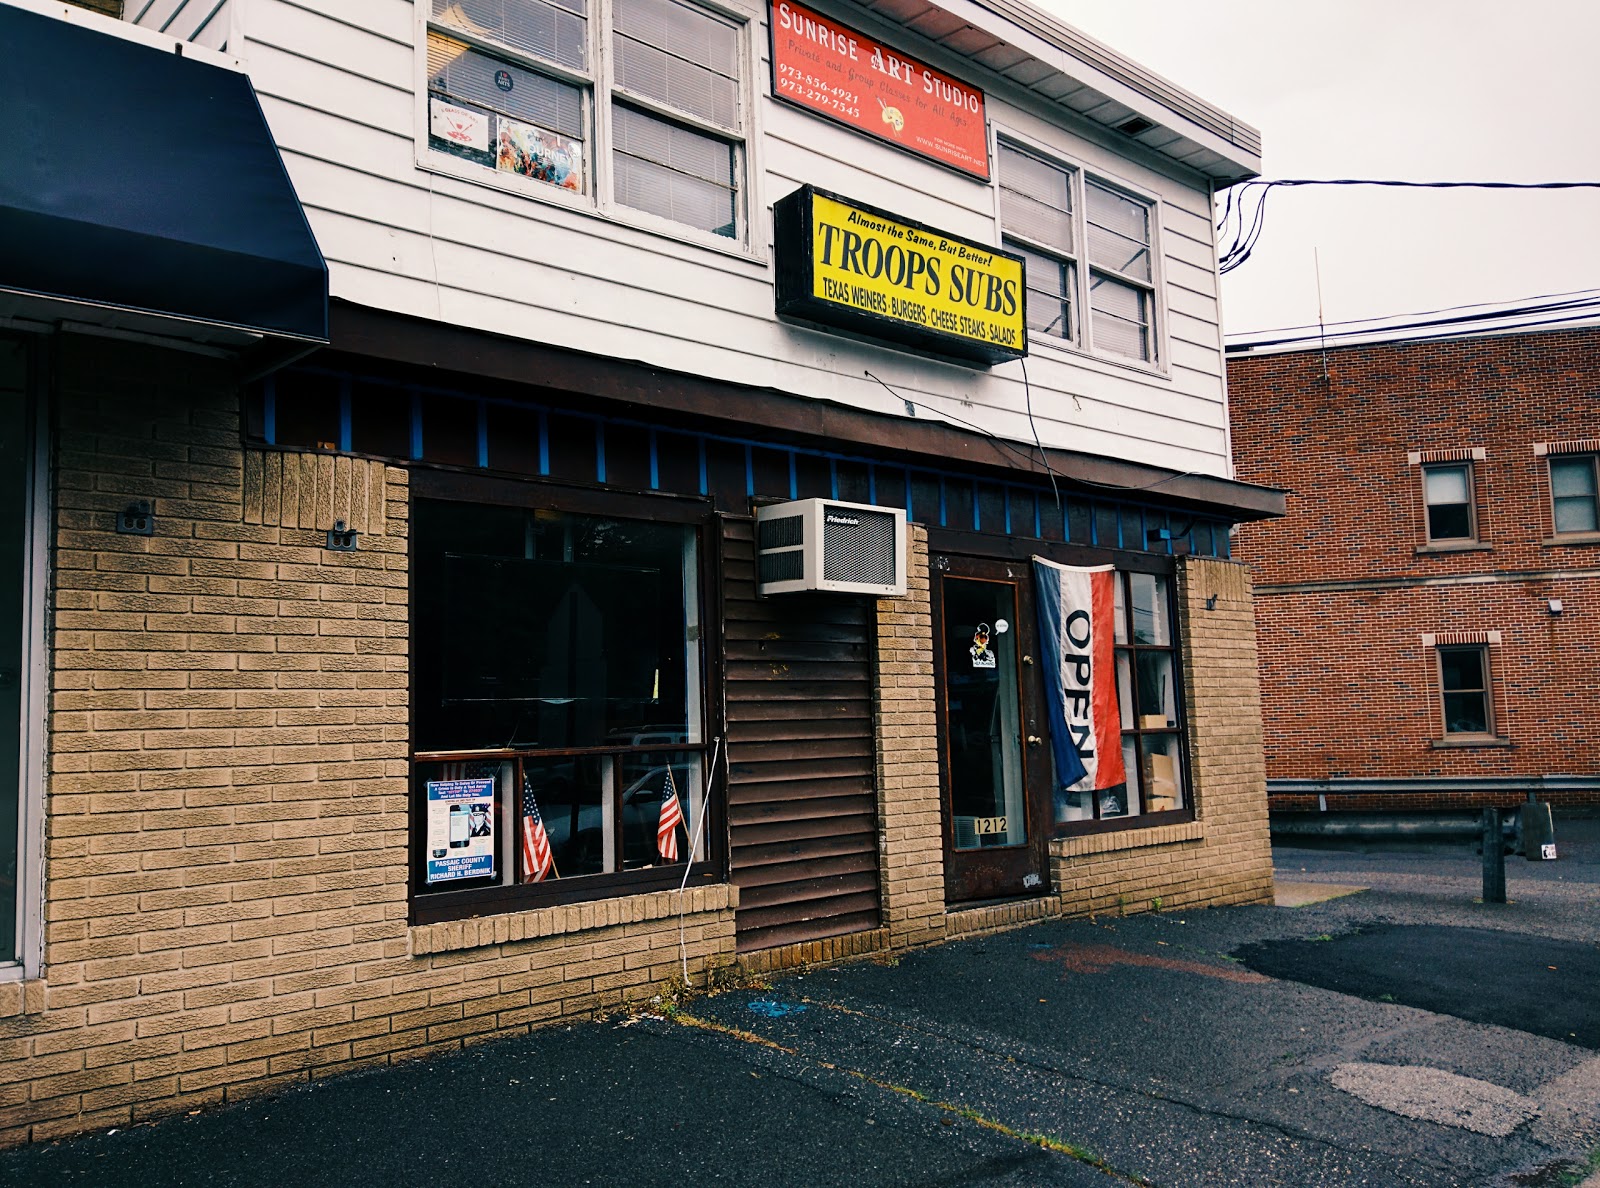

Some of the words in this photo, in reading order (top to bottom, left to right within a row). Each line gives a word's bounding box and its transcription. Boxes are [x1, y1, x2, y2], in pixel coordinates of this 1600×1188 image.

[779, 2, 858, 62] SUNRISE
[870, 46, 914, 85] ART
[922, 70, 979, 114] STUDIO
[788, 39, 821, 63] Private
[826, 59, 842, 73] and
[848, 67, 874, 88] Group
[879, 81, 910, 103] Classes
[915, 96, 928, 110] for
[932, 104, 945, 117] All
[779, 63, 859, 104] 973-856-4921
[780, 77, 860, 118] 973-279-7545
[526, 143, 572, 163] OURNEY
[847, 211, 886, 233] Almost
[887, 225, 904, 239] the
[905, 229, 937, 251] Same,
[938, 239, 957, 255] But
[958, 246, 993, 267] Better!
[818, 221, 941, 296] TROOPS
[949, 264, 1016, 316] SUBS
[823, 276, 850, 303] TEXAS
[851, 284, 887, 313] WEINERS
[891, 296, 927, 324] BURGERS
[930, 308, 958, 332] CHEESE
[959, 315, 986, 339] STEAKS
[989, 323, 1016, 345] SALADS
[826, 515, 860, 525] Friedrich
[1065, 609, 1094, 760] OPEN
[977, 817, 1007, 833] 1212
[430, 872, 455, 880] RICHARD
[464, 868, 491, 876] BERDNIK
[435, 859, 460, 867] PASSAIC
[461, 857, 485, 865] COUNTY
